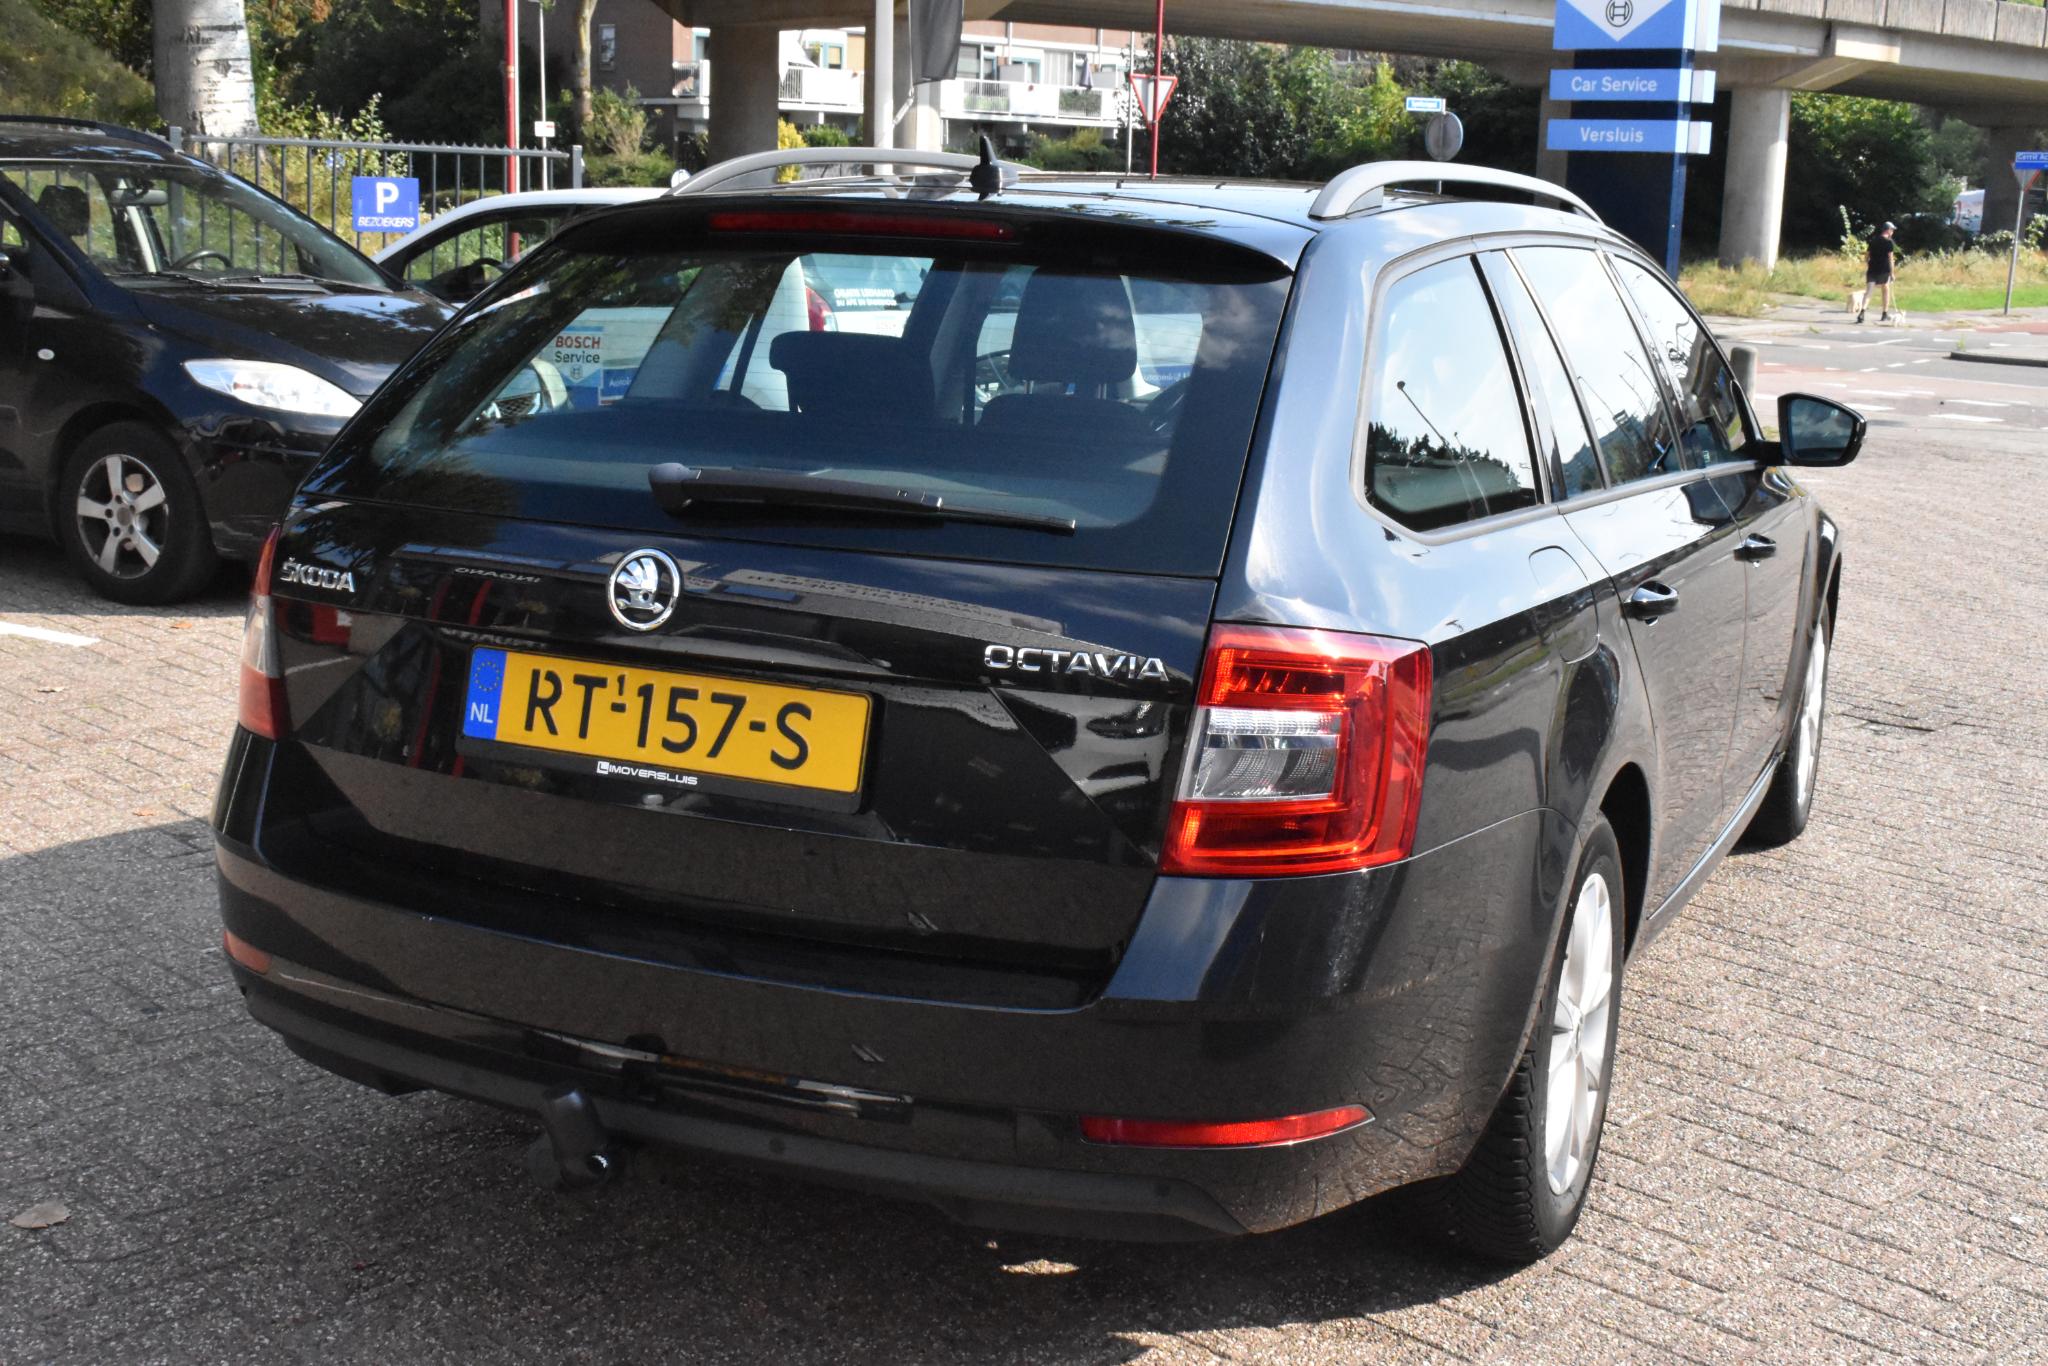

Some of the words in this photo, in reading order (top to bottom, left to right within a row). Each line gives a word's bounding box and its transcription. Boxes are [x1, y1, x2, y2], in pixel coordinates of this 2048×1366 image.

[1571, 76, 1597, 92] Car
[1601, 76, 1657, 92] Service
[1580, 127, 1644, 143] Versluis
[376, 182, 399, 214] P
[358, 216, 415, 228] BEZOEKERS
[555, 336, 601, 349] BOSCH
[554, 351, 600, 364] Service
[280, 557, 355, 593] ŠKODA
[984, 644, 1170, 682] OCTAVIA
[470, 701, 494, 725] NL
